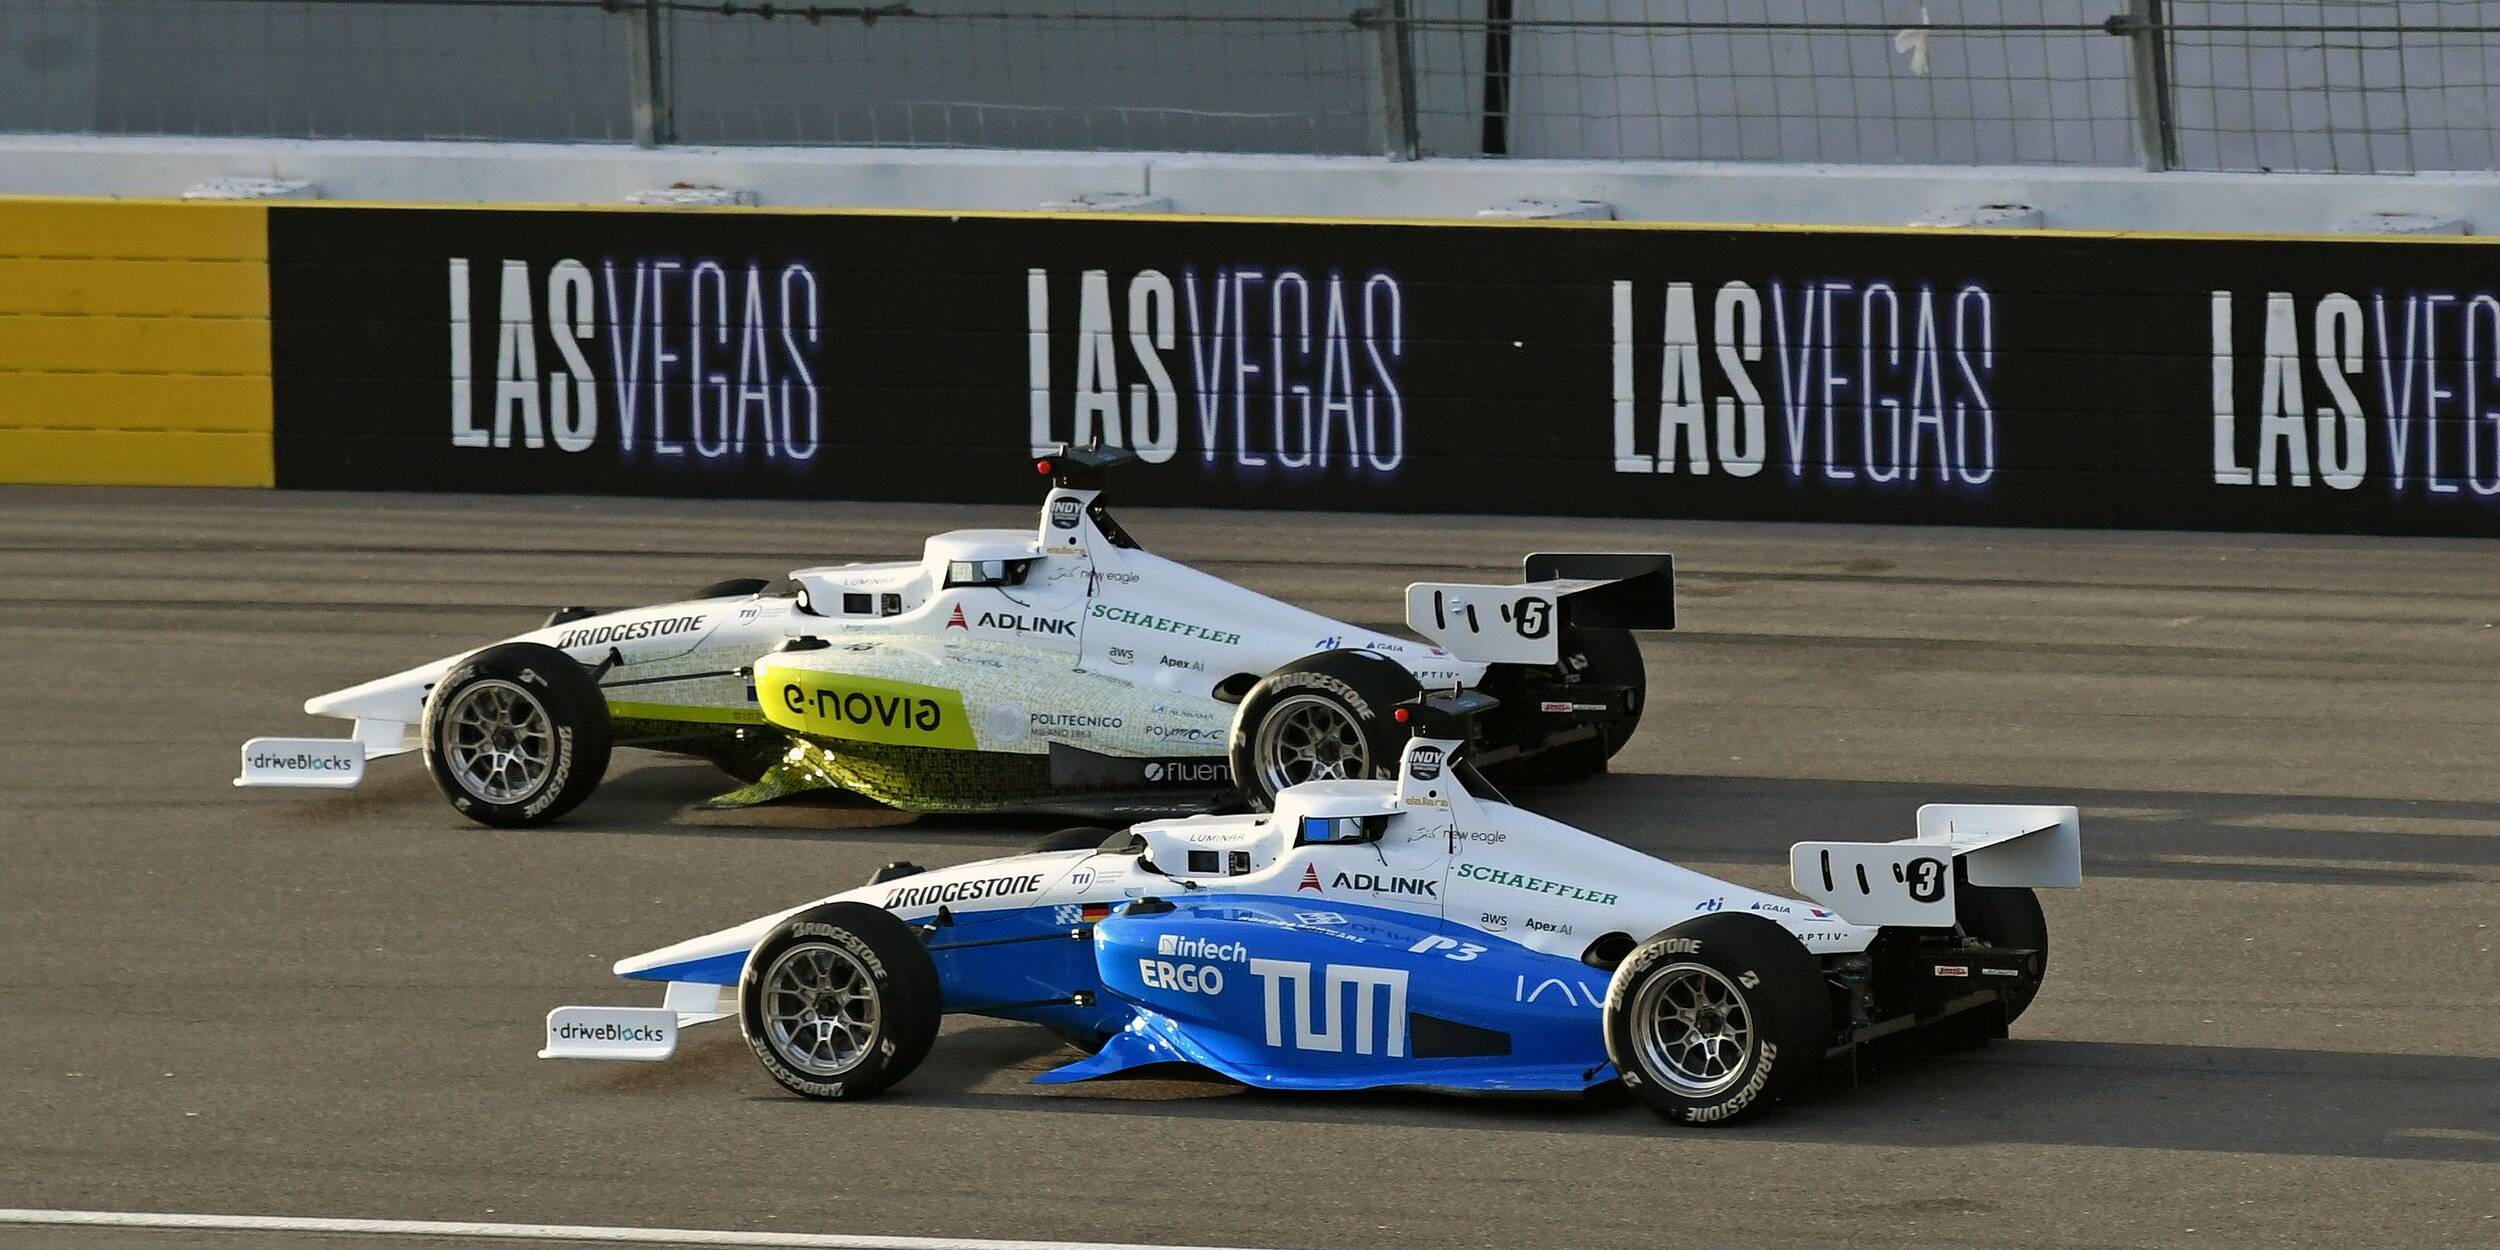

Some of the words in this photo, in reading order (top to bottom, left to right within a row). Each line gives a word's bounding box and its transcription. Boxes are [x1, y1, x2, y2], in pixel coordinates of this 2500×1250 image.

[449, 258, 598, 453] LAS
[604, 260, 819, 459] VEGAS
[1027, 267, 1178, 464] LAS
[1185, 270, 1404, 471] VEGAS
[1612, 279, 1766, 478] LAS
[1773, 281, 1994, 484] VEGAS
[2211, 290, 2367, 490] LAS
[1052, 502, 1083, 514] INDY
[1106, 573, 1140, 585] eagle
[556, 614, 707, 649] BRIDGESTONE
[977, 611, 1077, 638] ADLINK
[1091, 603, 1241, 645] SCHAEFFLER
[1523, 601, 1545, 635] 5
[1109, 646, 1135, 661] aws
[1030, 713, 1123, 728] POLITECNICO
[1167, 762, 1232, 781] fluen
[1408, 751, 1444, 764] INDY
[1470, 831, 1507, 846] eagle
[884, 873, 1044, 910] BRIDGESTONE
[1331, 871, 1440, 897] ADLINK
[1457, 862, 1618, 906] SCHAEFFLER
[1916, 861, 1938, 896] 3
[1480, 912, 1508, 927] aws
[1761, 903, 1791, 914] GAIA
[1178, 936, 1247, 963] intech
[1408, 935, 1488, 962] P3
[1139, 958, 1224, 996] ERGO
[1250, 957, 1410, 1058] TUM
[1685, 1039, 1778, 1122] BRIDGESTONE
